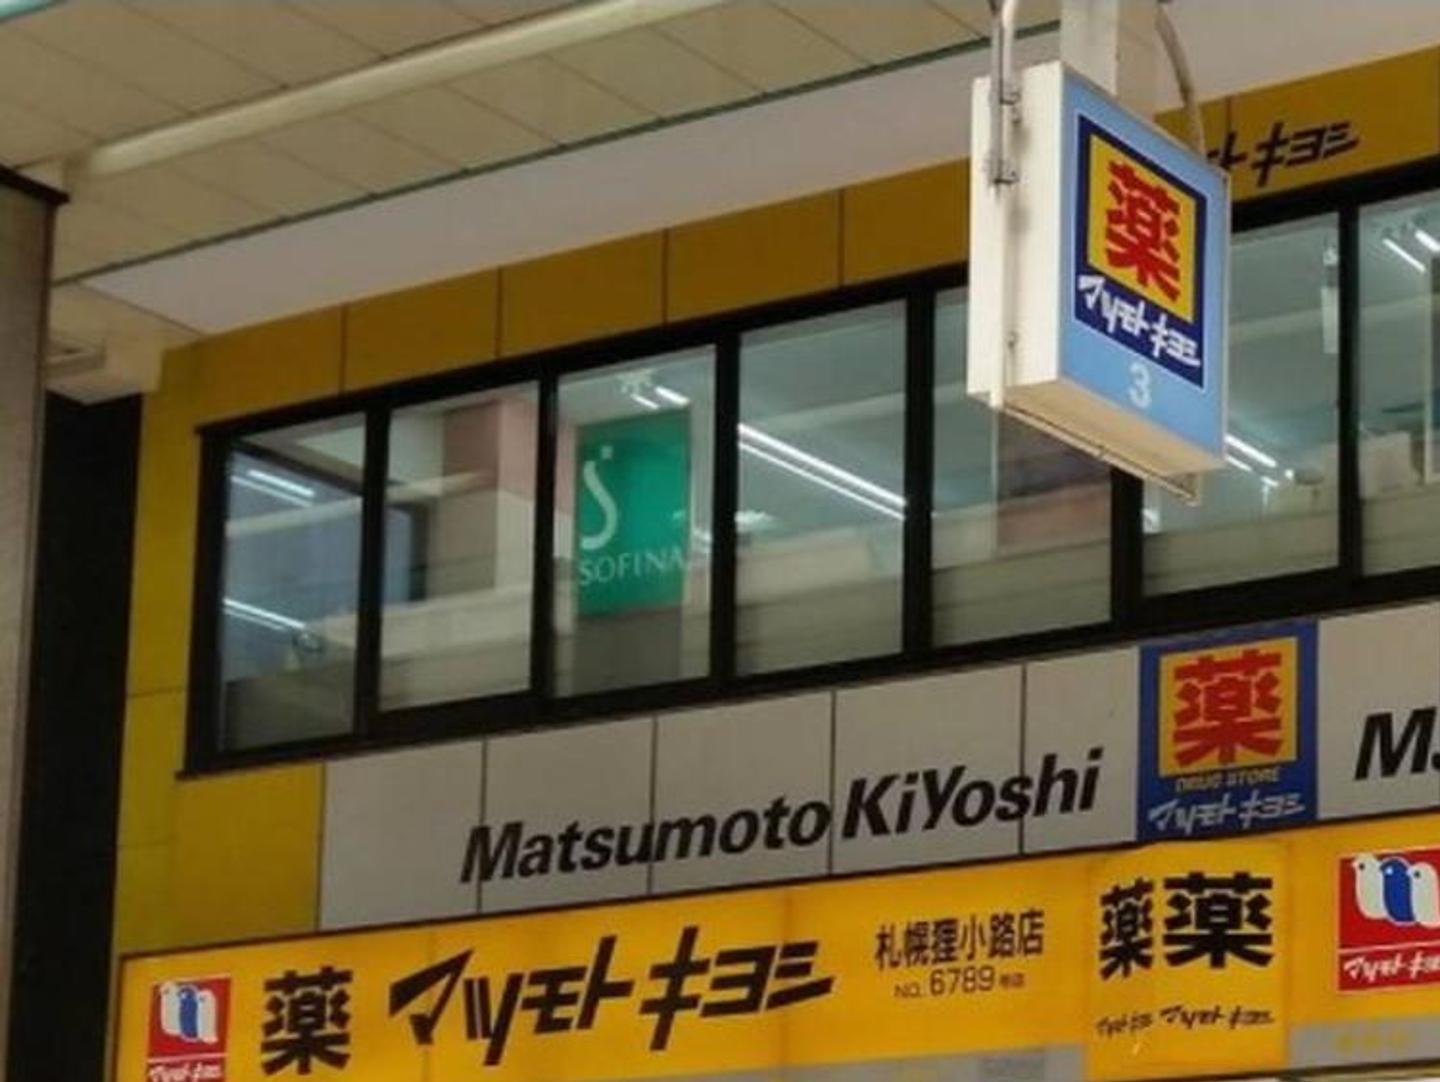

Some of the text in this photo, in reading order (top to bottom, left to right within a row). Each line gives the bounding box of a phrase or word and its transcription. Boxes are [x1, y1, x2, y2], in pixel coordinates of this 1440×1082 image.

[1205, 122, 1360, 188] トキヨシ
[1106, 158, 1180, 303] 薬
[1078, 273, 1202, 368] マツモトキヨシ
[1128, 362, 1152, 408] 3
[1173, 648, 1284, 767] 薬
[460, 746, 1105, 884] Matsumoto KiYoshi
[1149, 788, 1306, 836] マツモトキヨシ
[875, 909, 1045, 971] 札幌狸小路店
[1099, 877, 1153, 981] 薬
[1162, 871, 1274, 969] 薬
[260, 925, 835, 1076] 薬 マツモトキヨシ
[929, 964, 996, 996] 6789
[1160, 1005, 1275, 1030] マツモトキヨシ
